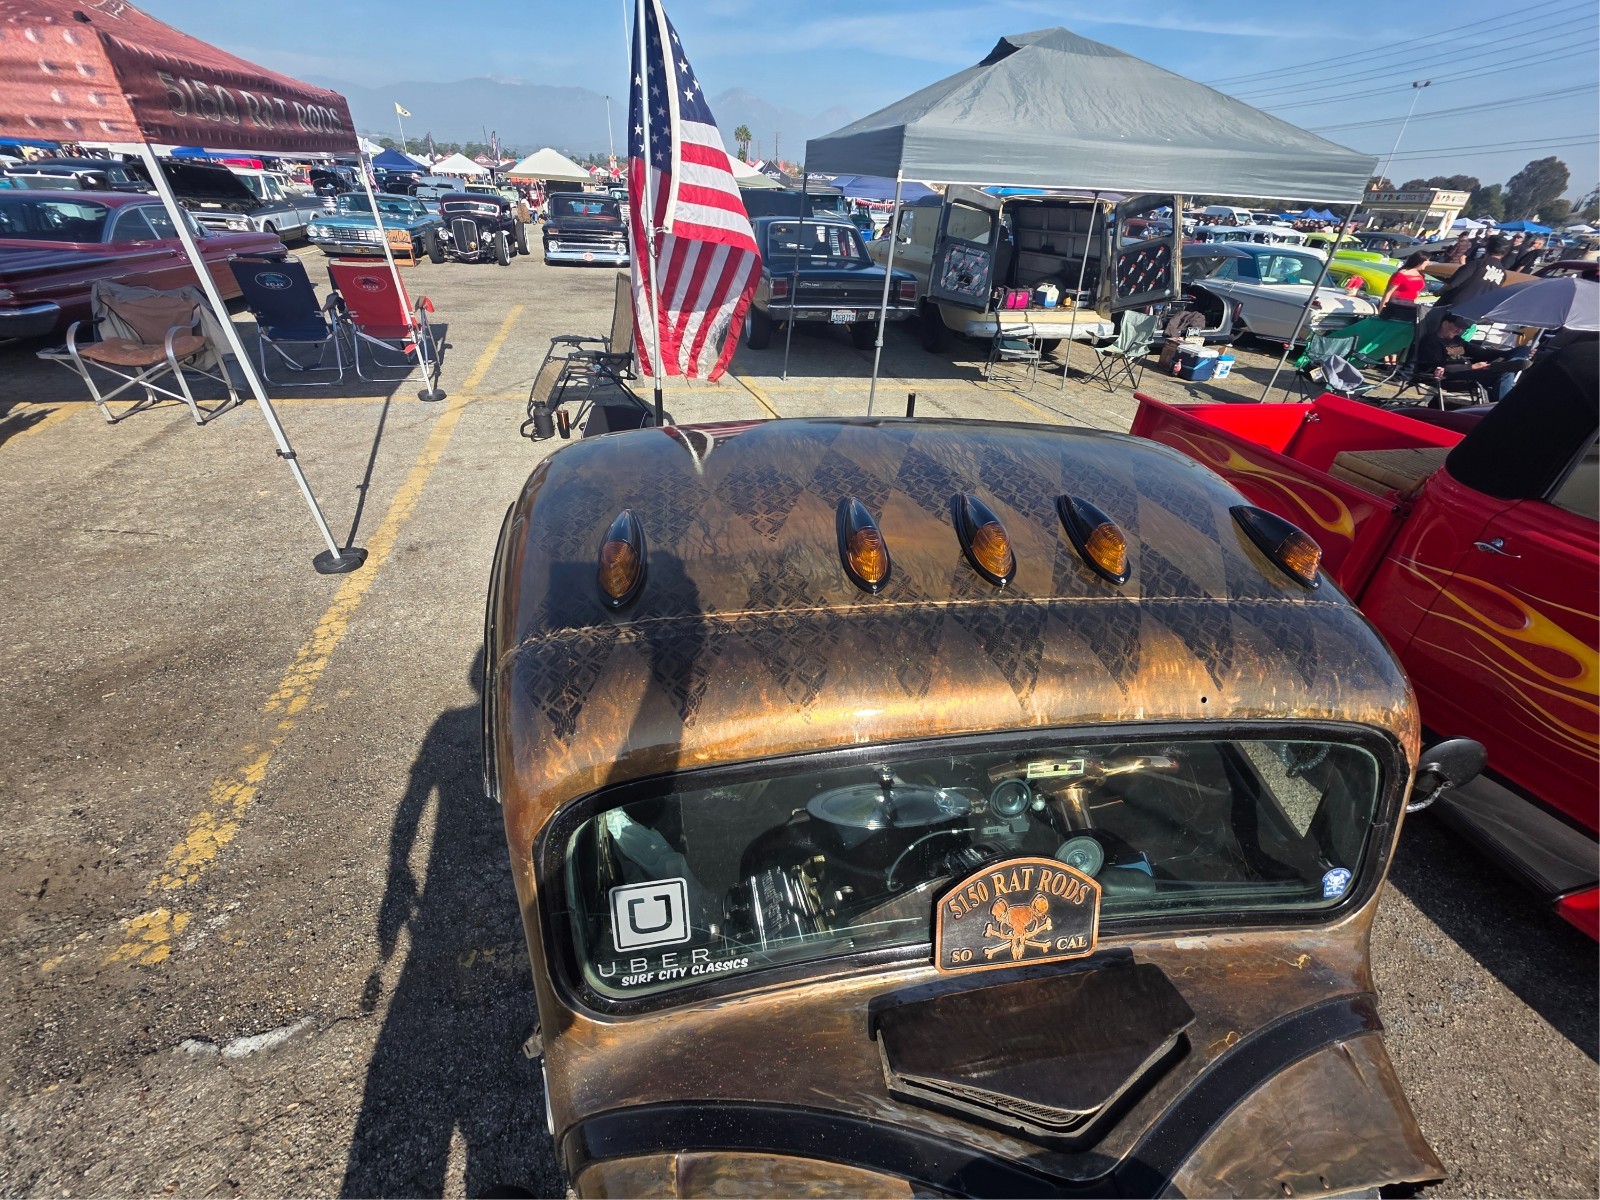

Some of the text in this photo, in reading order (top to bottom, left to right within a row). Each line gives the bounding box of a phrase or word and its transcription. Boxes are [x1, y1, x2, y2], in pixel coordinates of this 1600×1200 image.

[157, 70, 344, 135] 5150 RAT RODS
[948, 866, 1091, 920] 5150 RAT RODS
[597, 948, 710, 978] UBER
[951, 935, 1088, 963] SO CAL
[621, 957, 749, 987] SURF CITY CLASSICS
